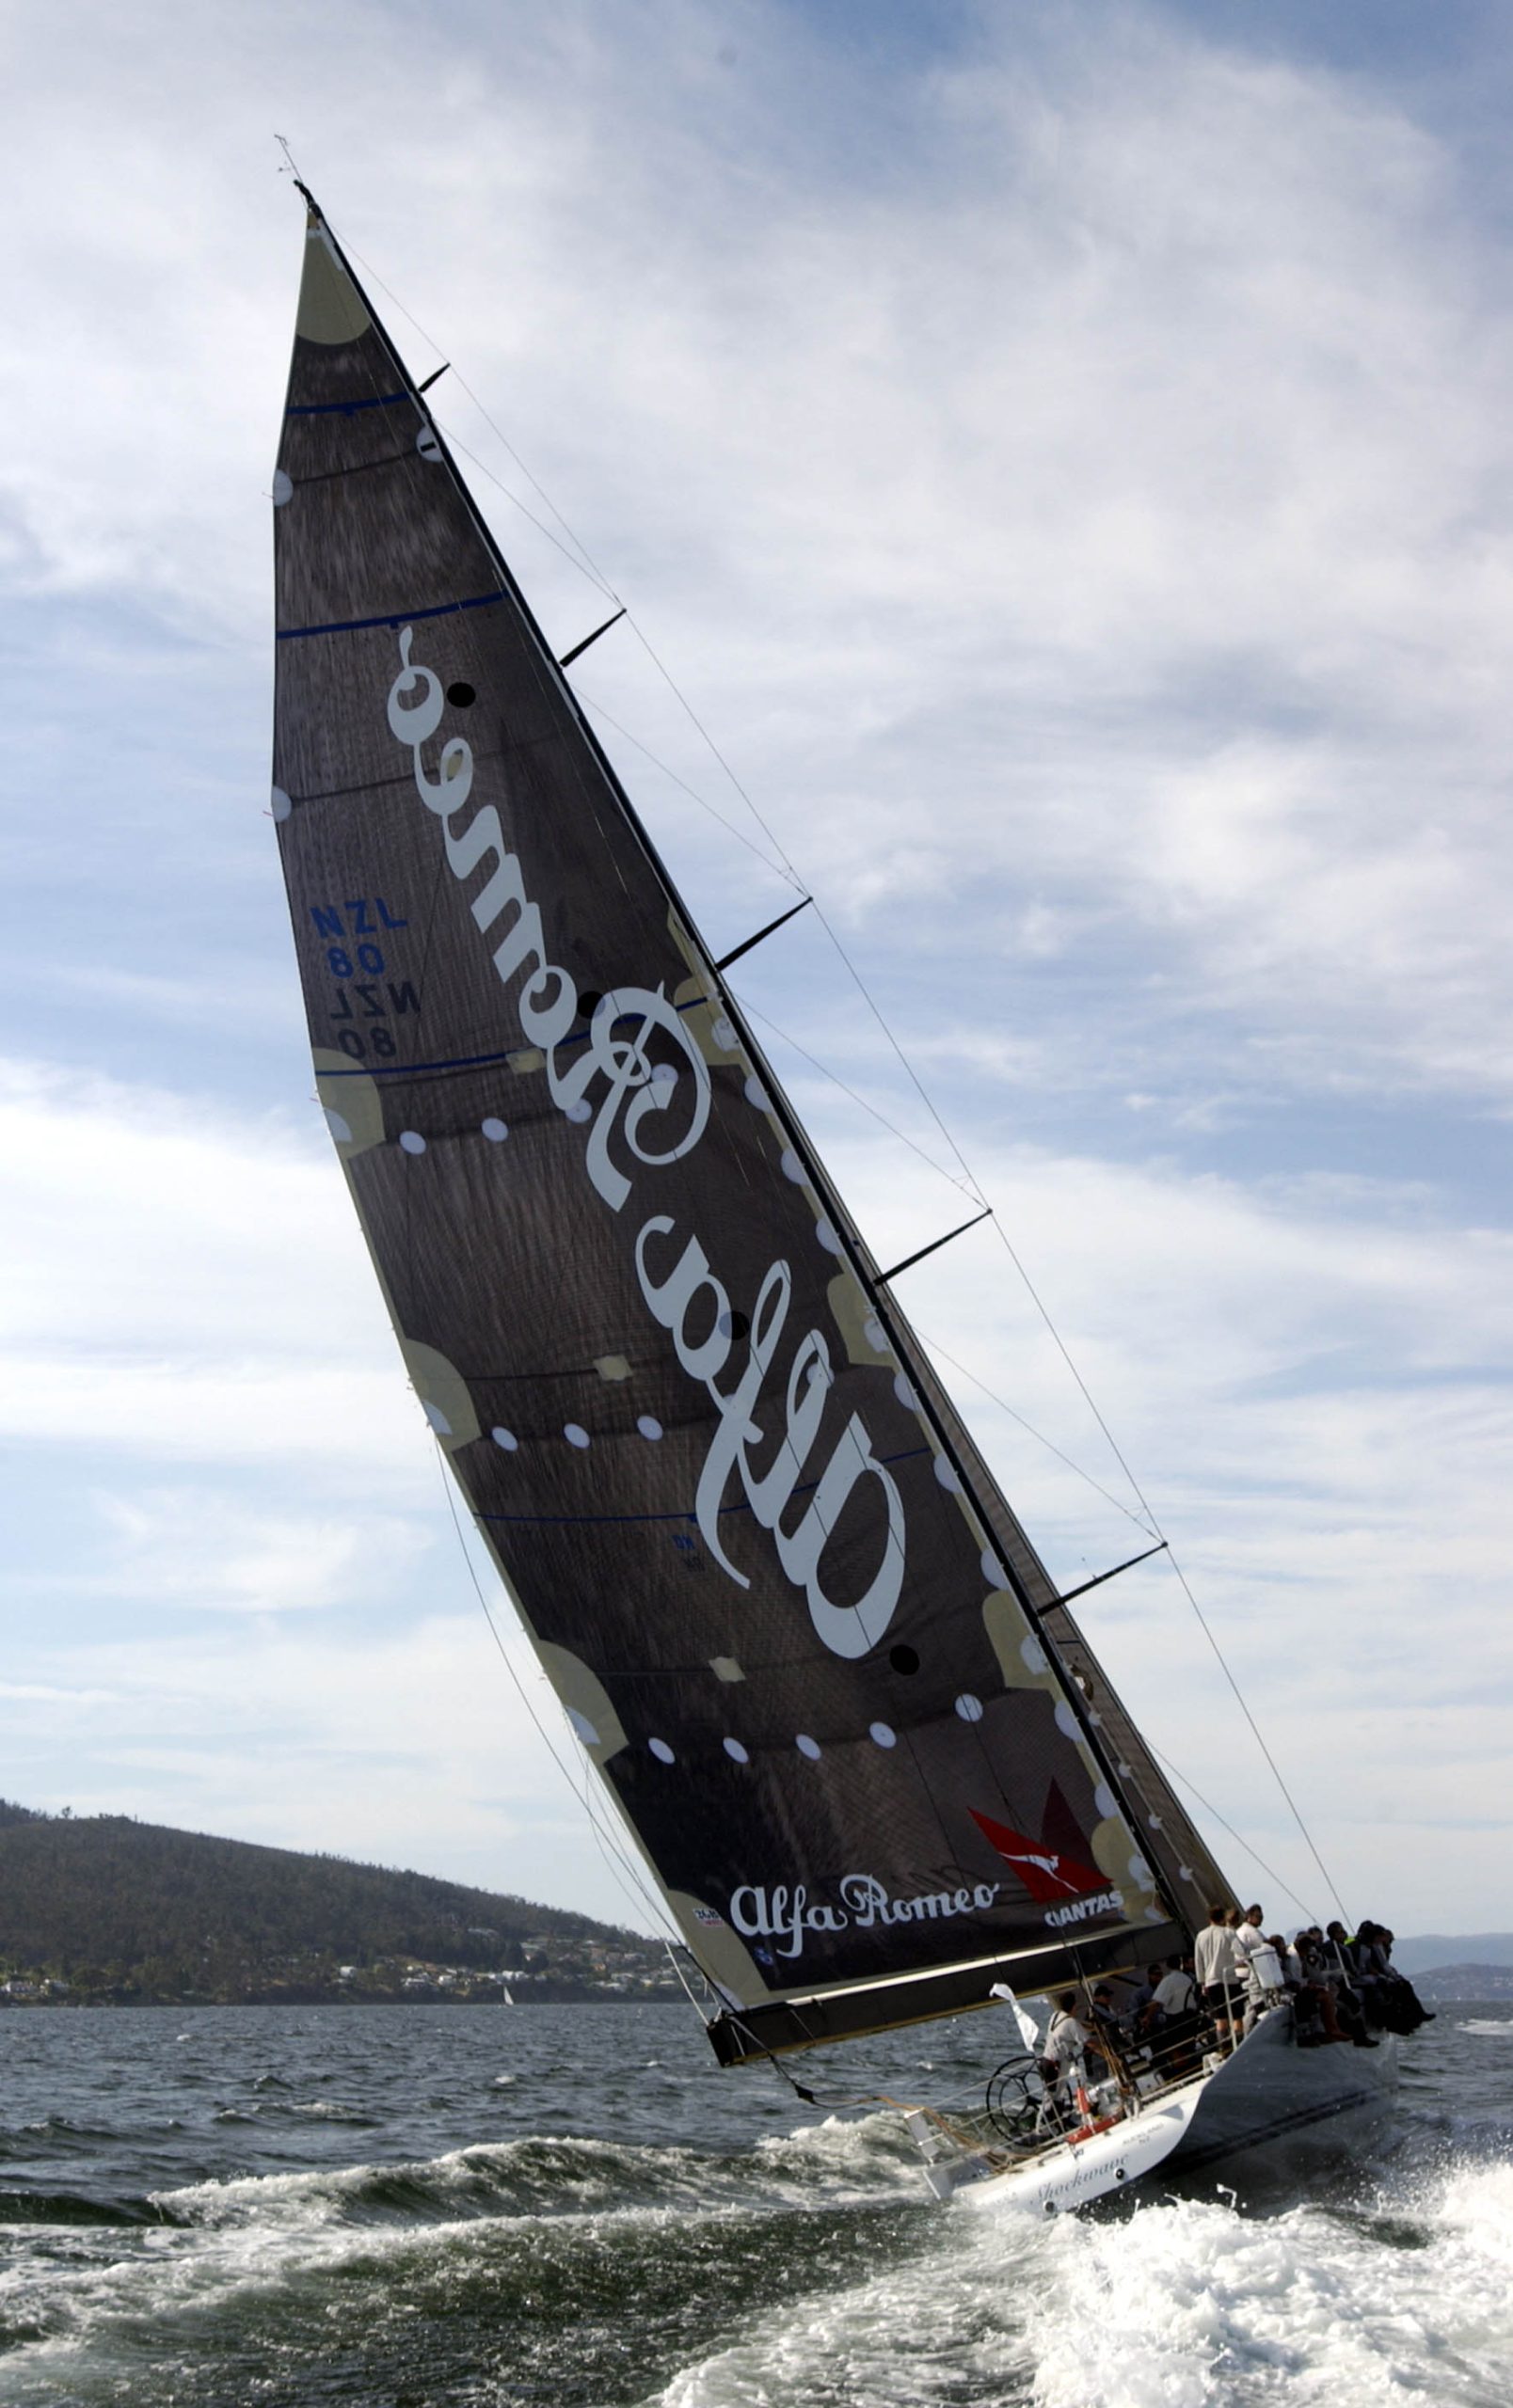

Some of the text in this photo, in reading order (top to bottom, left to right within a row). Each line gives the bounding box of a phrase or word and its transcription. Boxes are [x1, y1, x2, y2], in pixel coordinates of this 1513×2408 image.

[310, 896, 408, 939] NZL
[387, 625, 711, 1212] Romeo
[326, 943, 386, 979] 80
[839, 1873, 1000, 1927] Romeo
[1043, 1889, 1124, 1927] QANTAS
